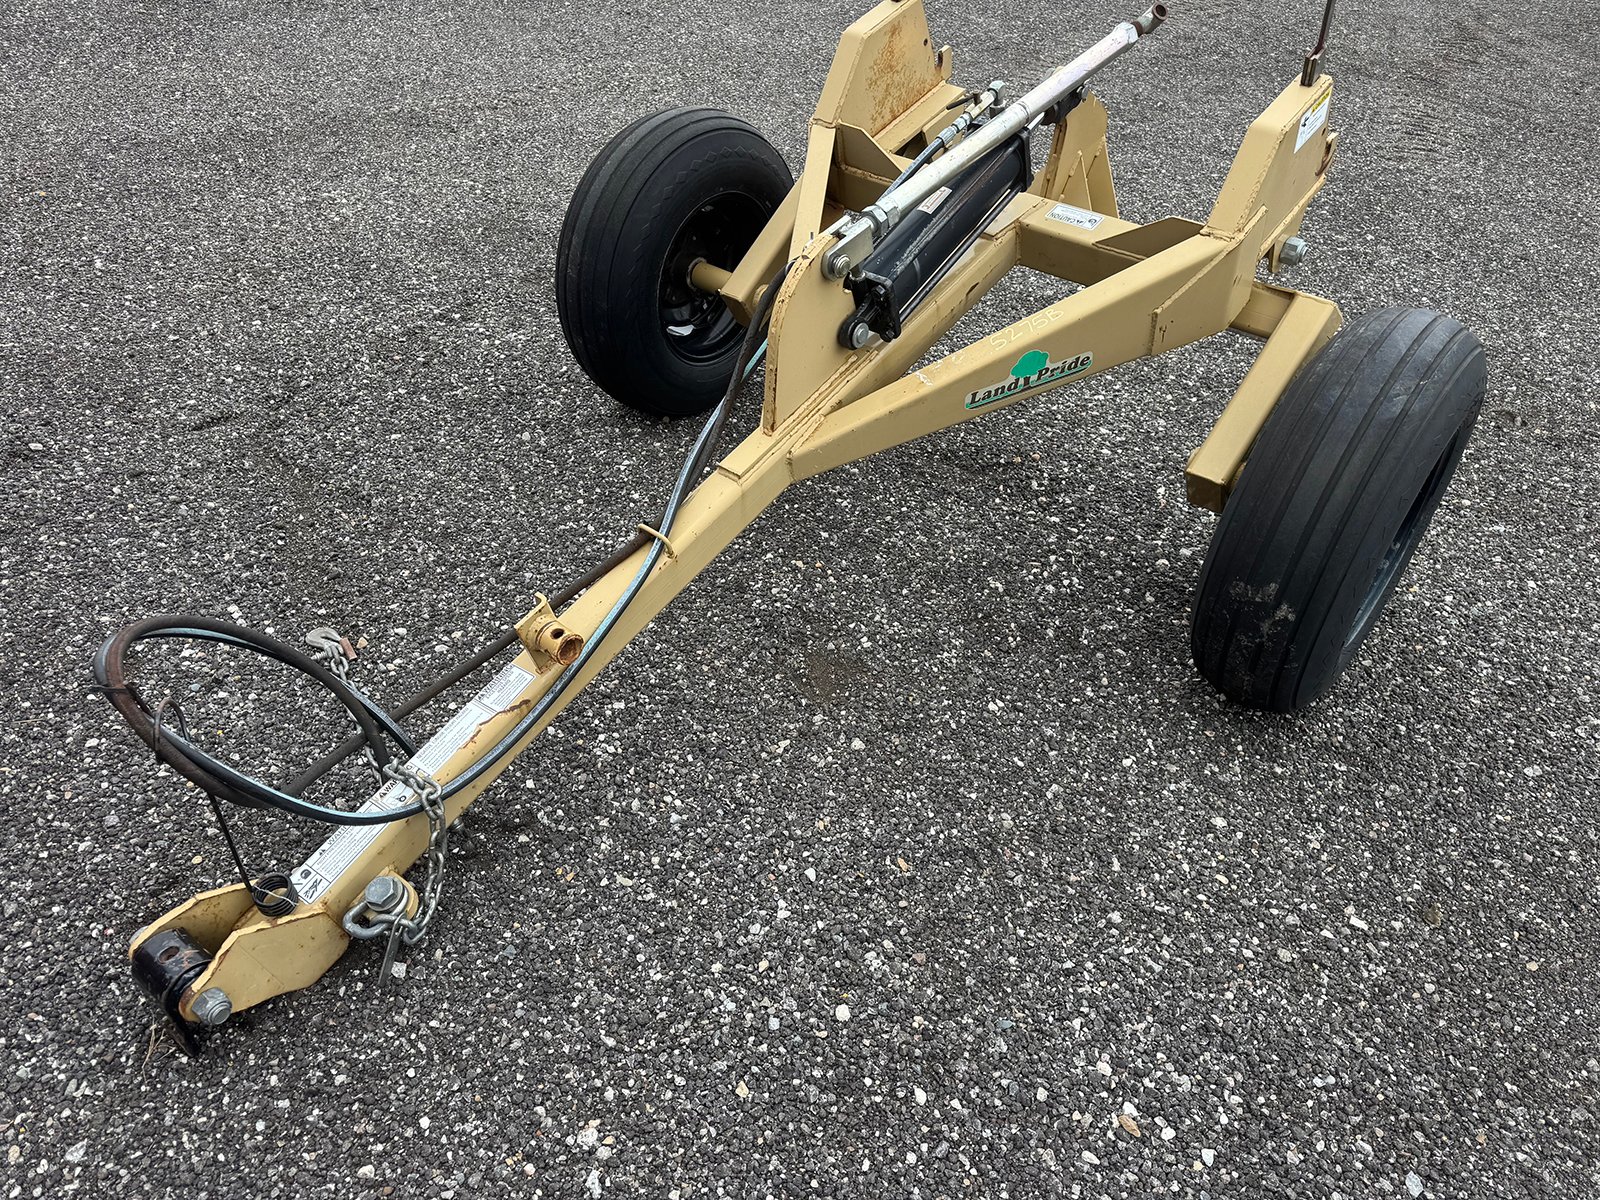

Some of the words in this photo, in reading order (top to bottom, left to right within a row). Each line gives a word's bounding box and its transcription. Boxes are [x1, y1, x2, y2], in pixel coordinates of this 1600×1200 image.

[1049, 211, 1077, 224] CAUTION
[990, 308, 1064, 351] 5275B
[969, 376, 1021, 406] Land
[1036, 354, 1091, 383] Pride
